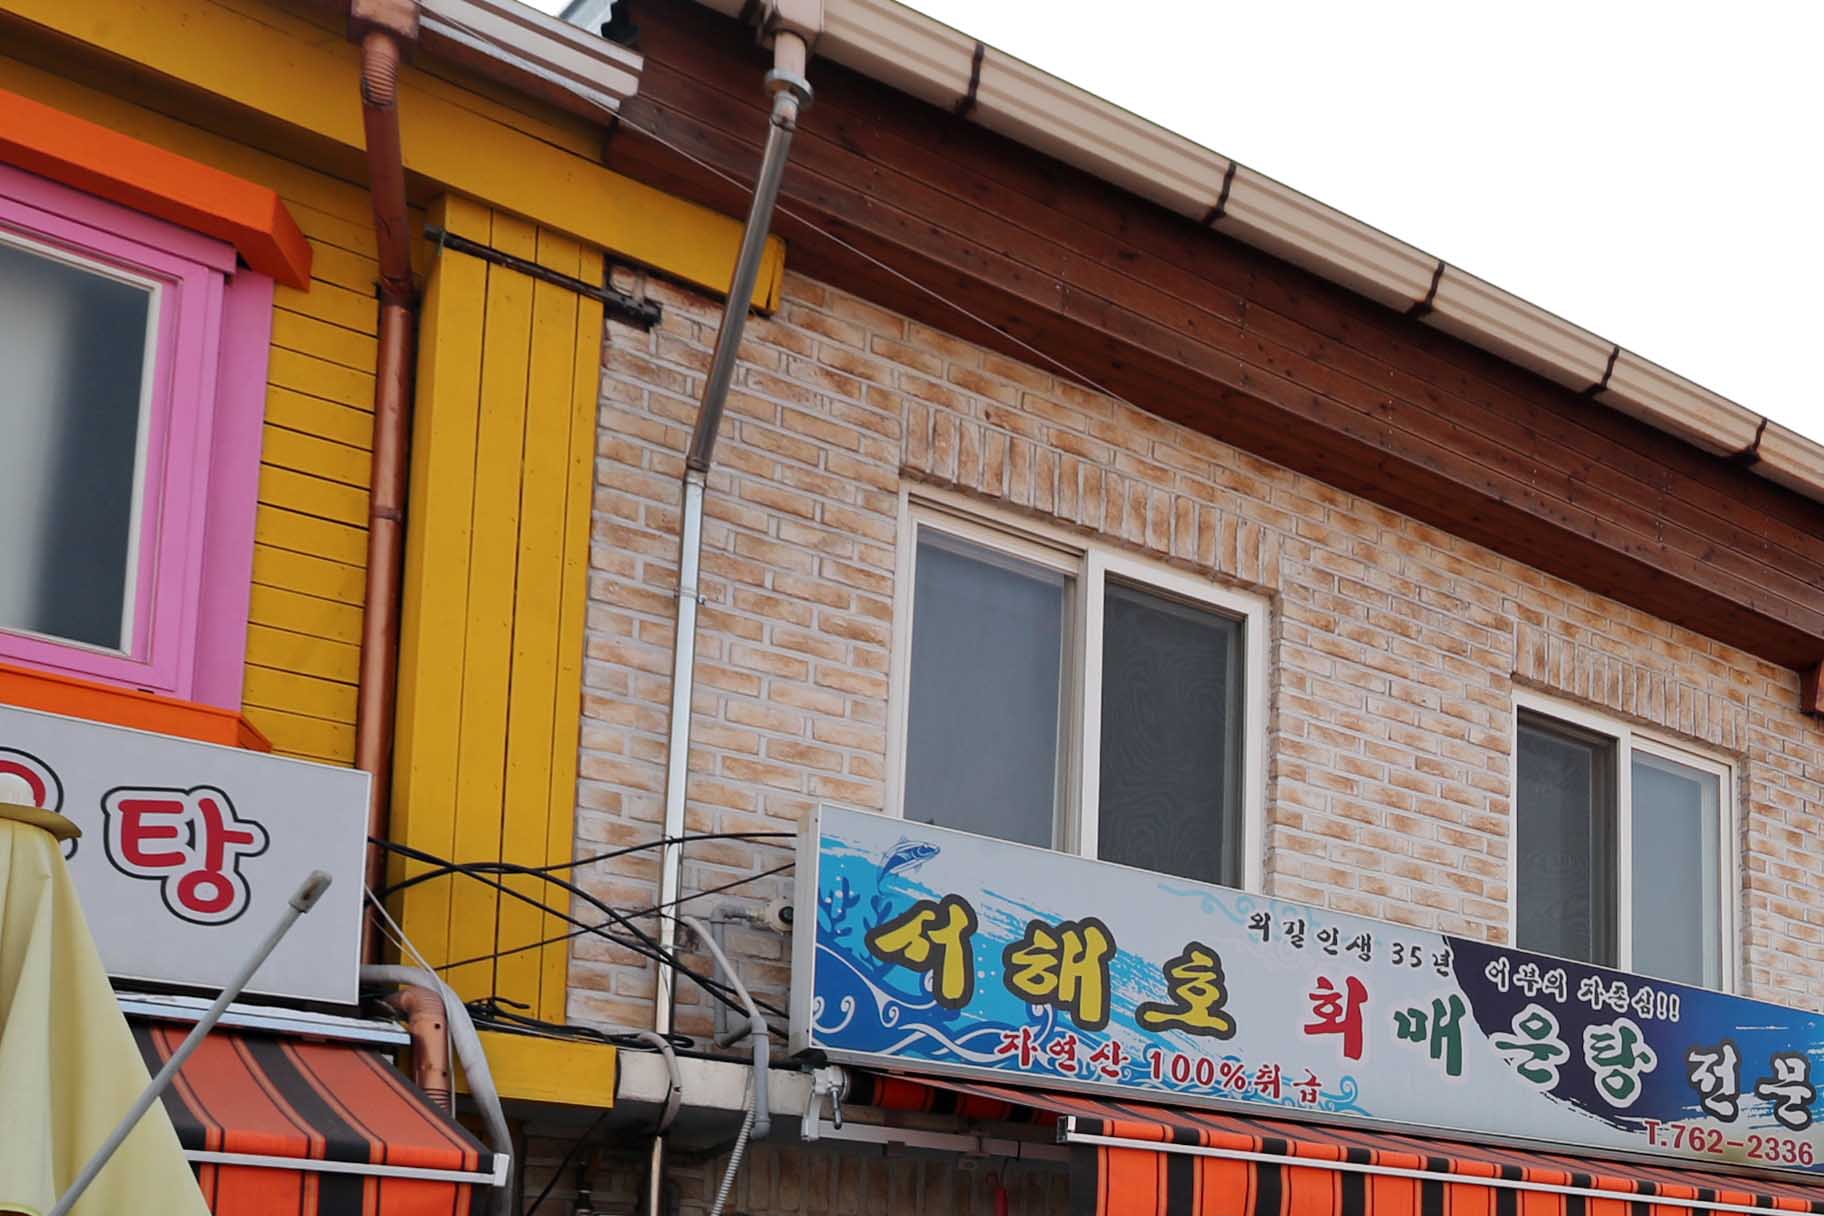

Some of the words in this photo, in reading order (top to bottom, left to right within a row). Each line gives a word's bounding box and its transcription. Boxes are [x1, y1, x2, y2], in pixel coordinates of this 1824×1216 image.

[866, 893, 1236, 1039] 서해호
[1484, 957, 1568, 1003] 어부의
[997, 1027, 1129, 1078] 자연산
[1303, 975, 1370, 1061] 회
[1392, 993, 1658, 1109] 매운탕
[1641, 1119, 1815, 1167] T.762-2336
